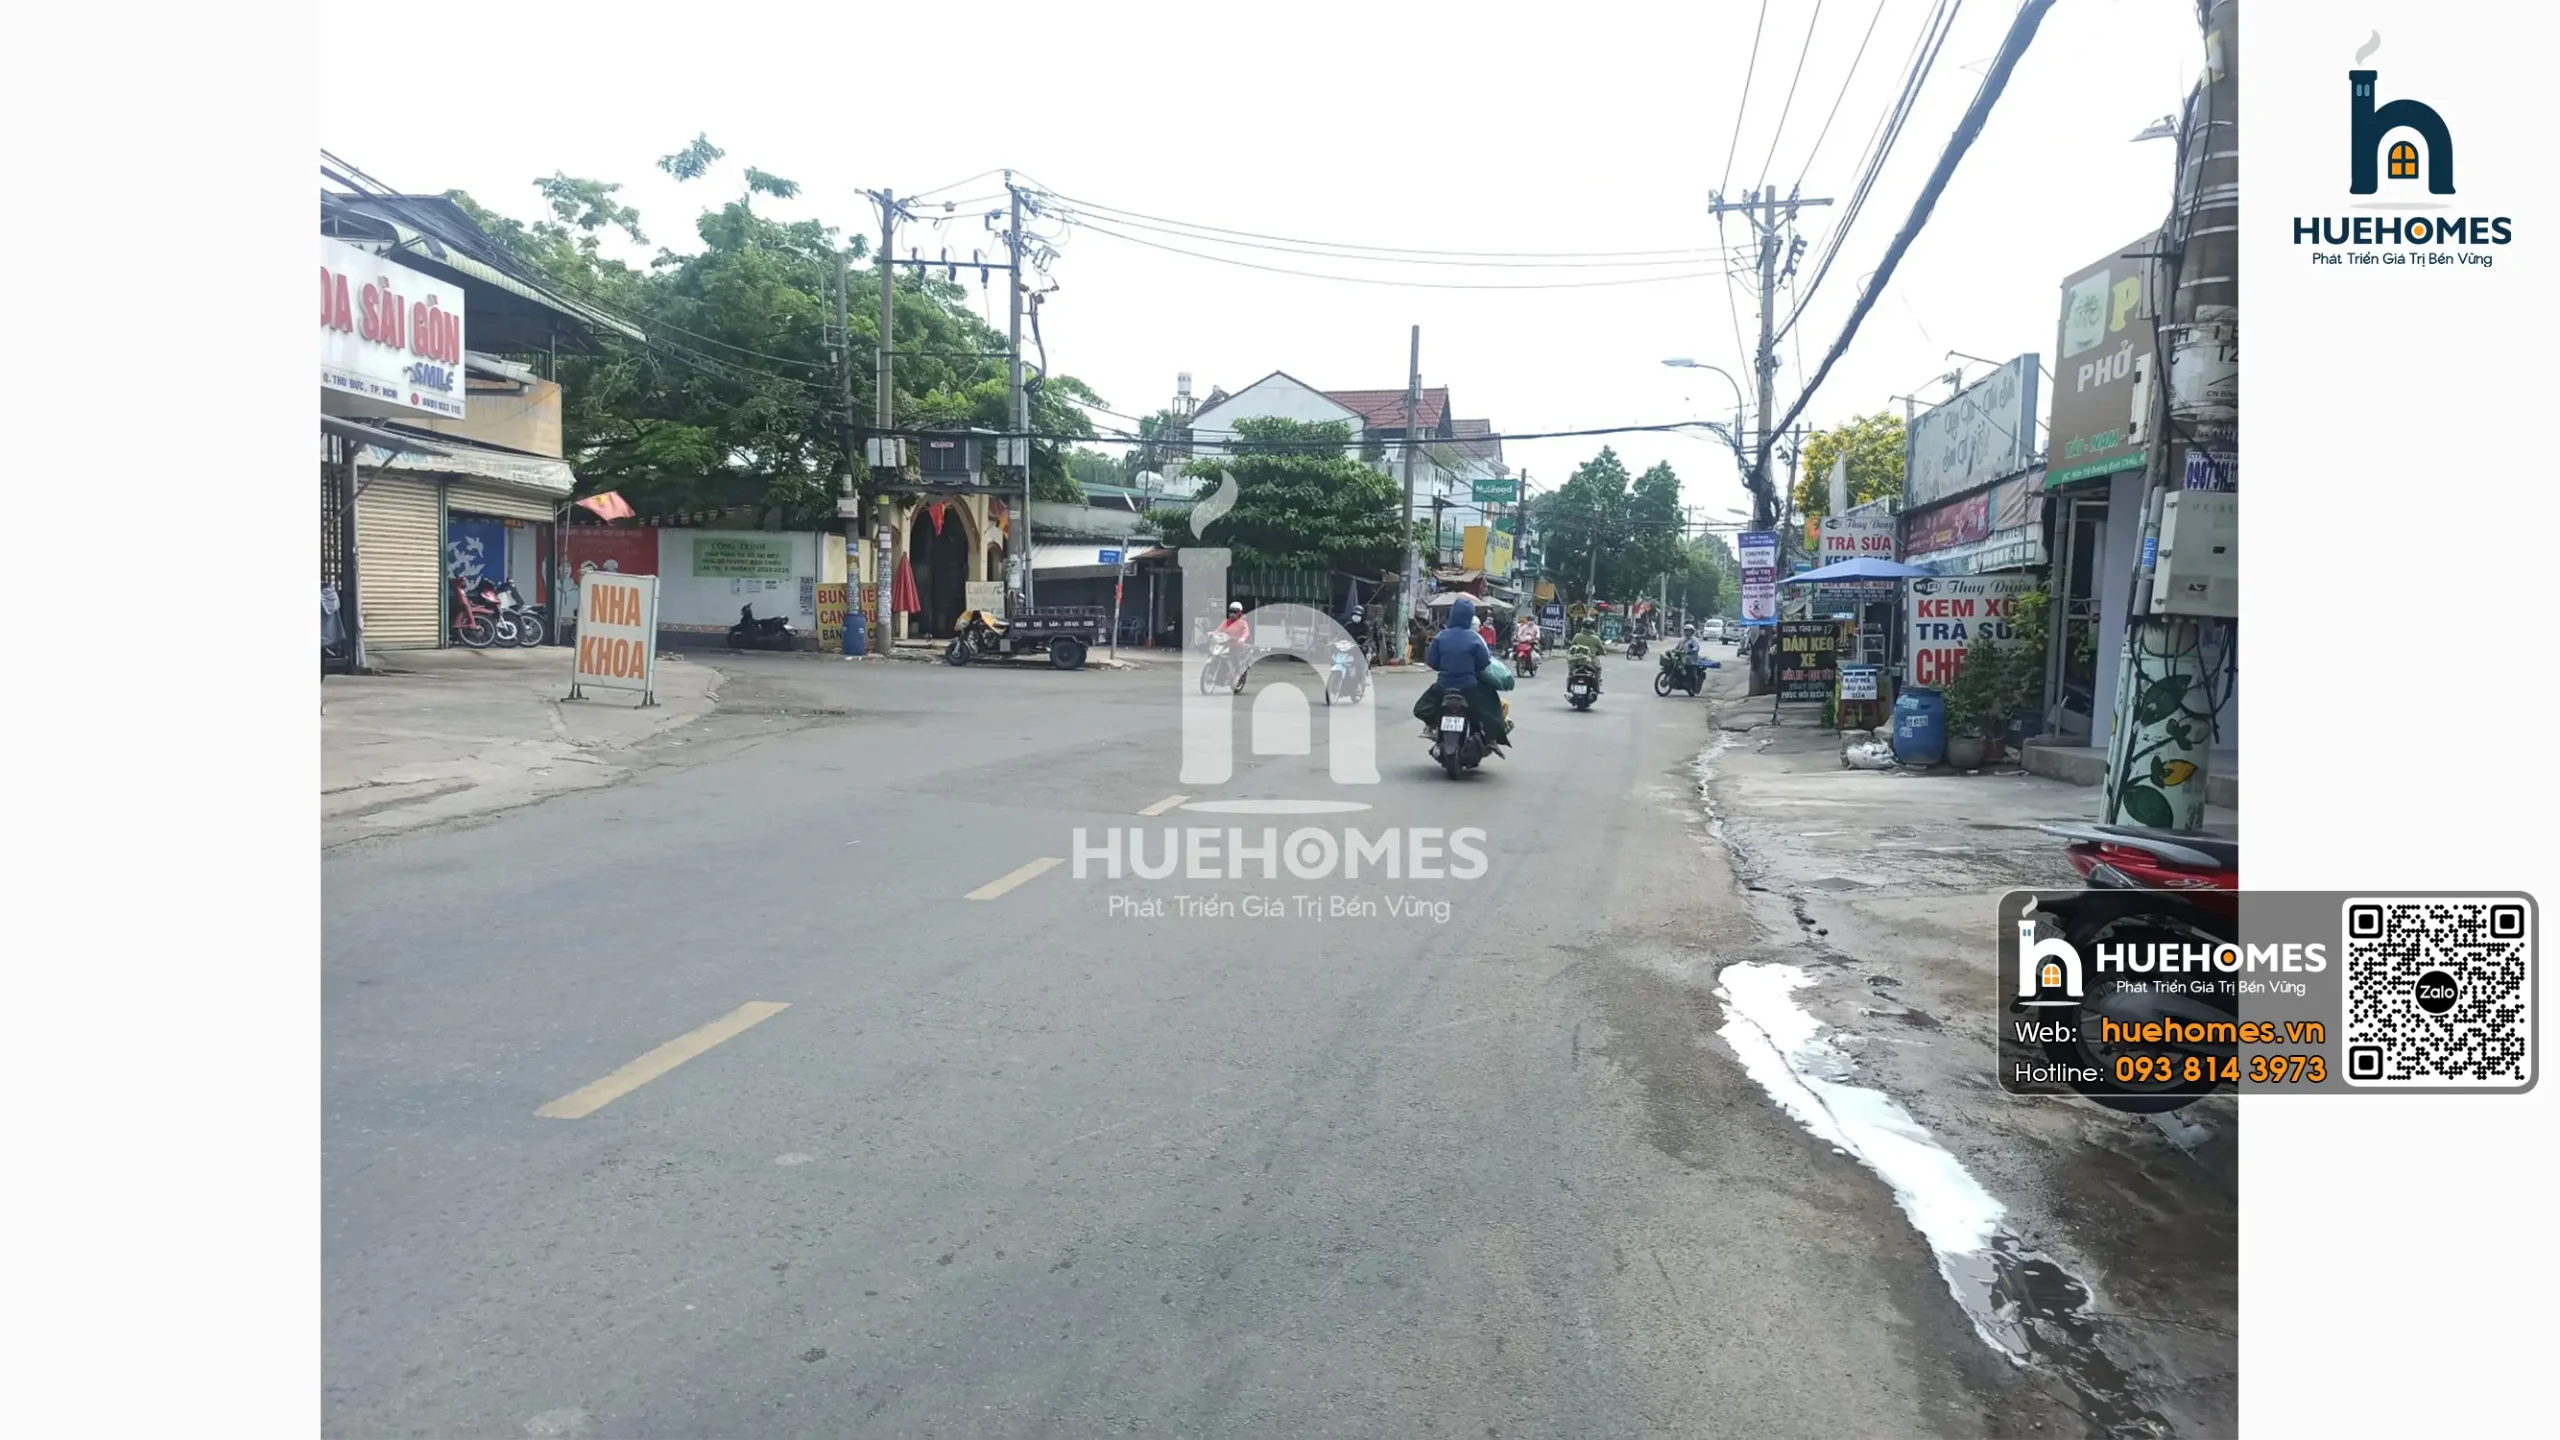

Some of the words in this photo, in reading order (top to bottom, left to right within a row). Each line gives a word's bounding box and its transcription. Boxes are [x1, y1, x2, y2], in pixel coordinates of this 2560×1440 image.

[358, 276, 405, 349] SÀI
[410, 294, 460, 365] GÒN
[2078, 339, 2134, 393] PHỞ
[1826, 533, 1855, 551] TRÀ
[1861, 534, 1892, 551] SỮA
[1947, 580, 1984, 595] Thùy
[590, 584, 642, 627] NHA
[1918, 599, 1974, 618] KEM
[1916, 619, 1968, 640] TRÀ
[1782, 635, 1808, 652] DÁN
[579, 635, 644, 680] KHOA
[1800, 653, 1817, 667] XE
